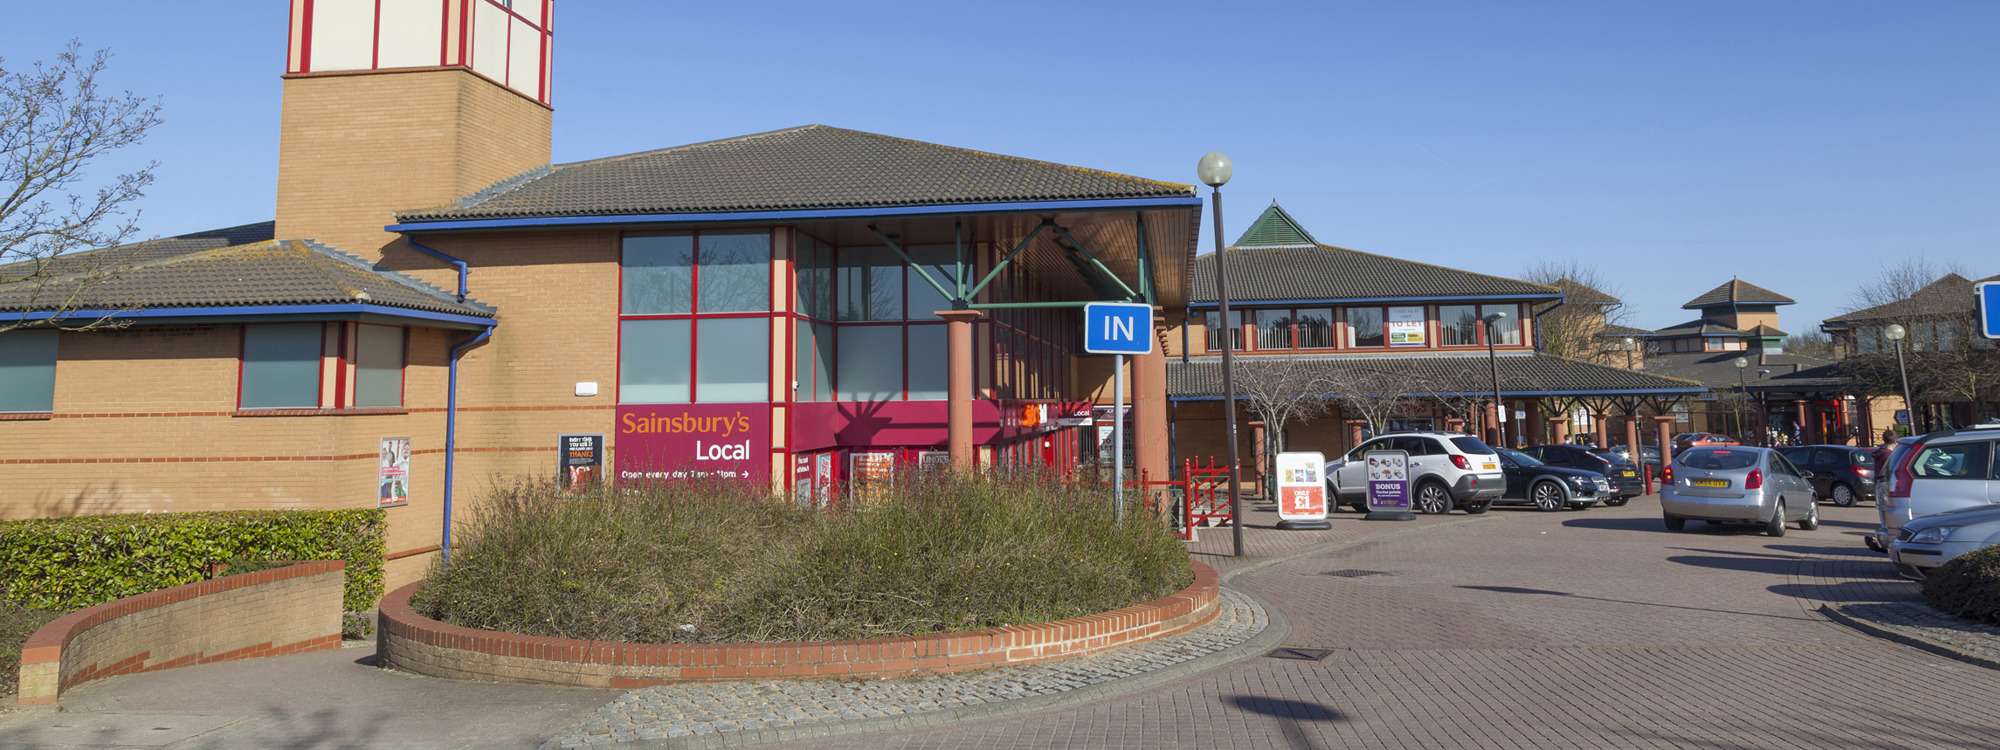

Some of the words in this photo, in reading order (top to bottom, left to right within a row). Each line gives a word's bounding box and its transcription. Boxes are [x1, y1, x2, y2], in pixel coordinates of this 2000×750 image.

[1104, 315, 1134, 341] IN
[622, 411, 750, 438] Sainsbury's
[696, 439, 750, 460] Local
[922, 455, 949, 464] UNDER
[622, 470, 642, 479] Open
[646, 471, 669, 479] every
[672, 470, 688, 479] day
[1294, 496, 1311, 510] £1
